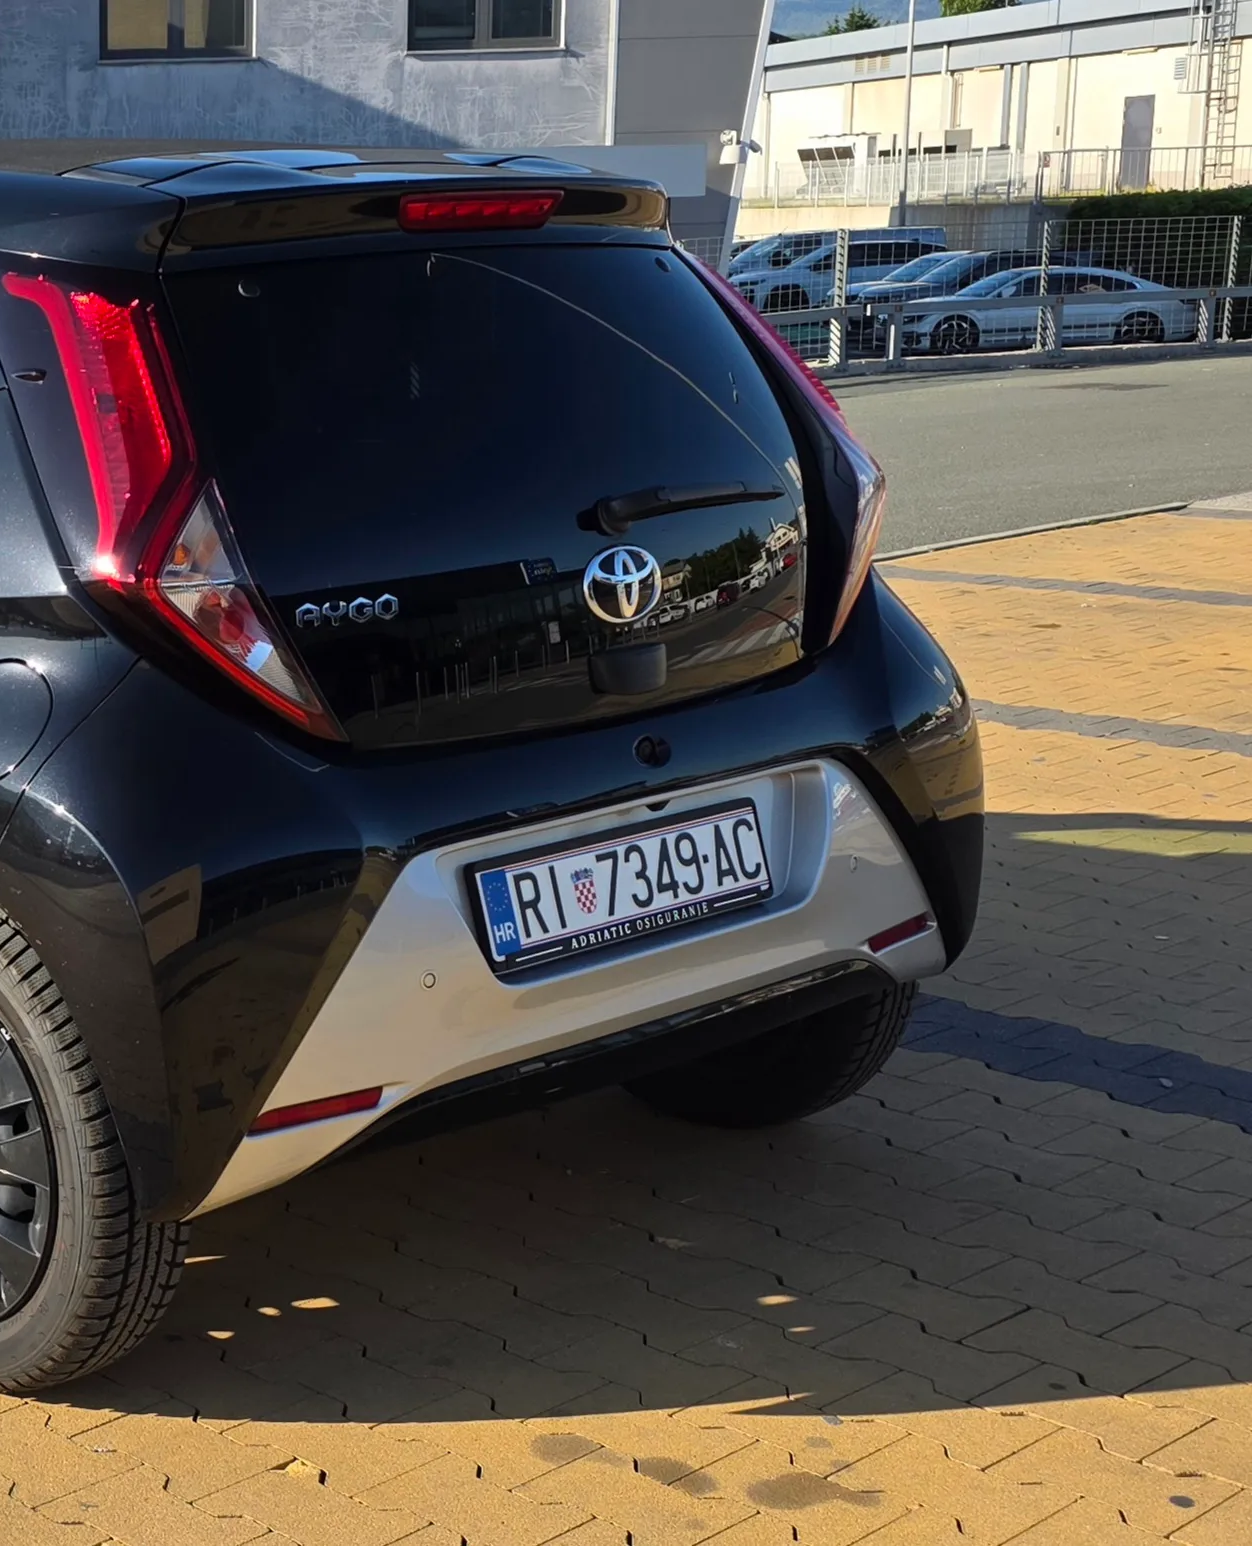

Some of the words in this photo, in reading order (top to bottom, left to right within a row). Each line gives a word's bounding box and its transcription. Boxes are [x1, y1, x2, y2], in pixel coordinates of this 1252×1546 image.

[295, 593, 400, 628] AYGO
[512, 865, 568, 939] RI
[494, 921, 517, 944] HR
[571, 922, 632, 950] ADRIATIC
[636, 901, 709, 931] OSIGURANJE
